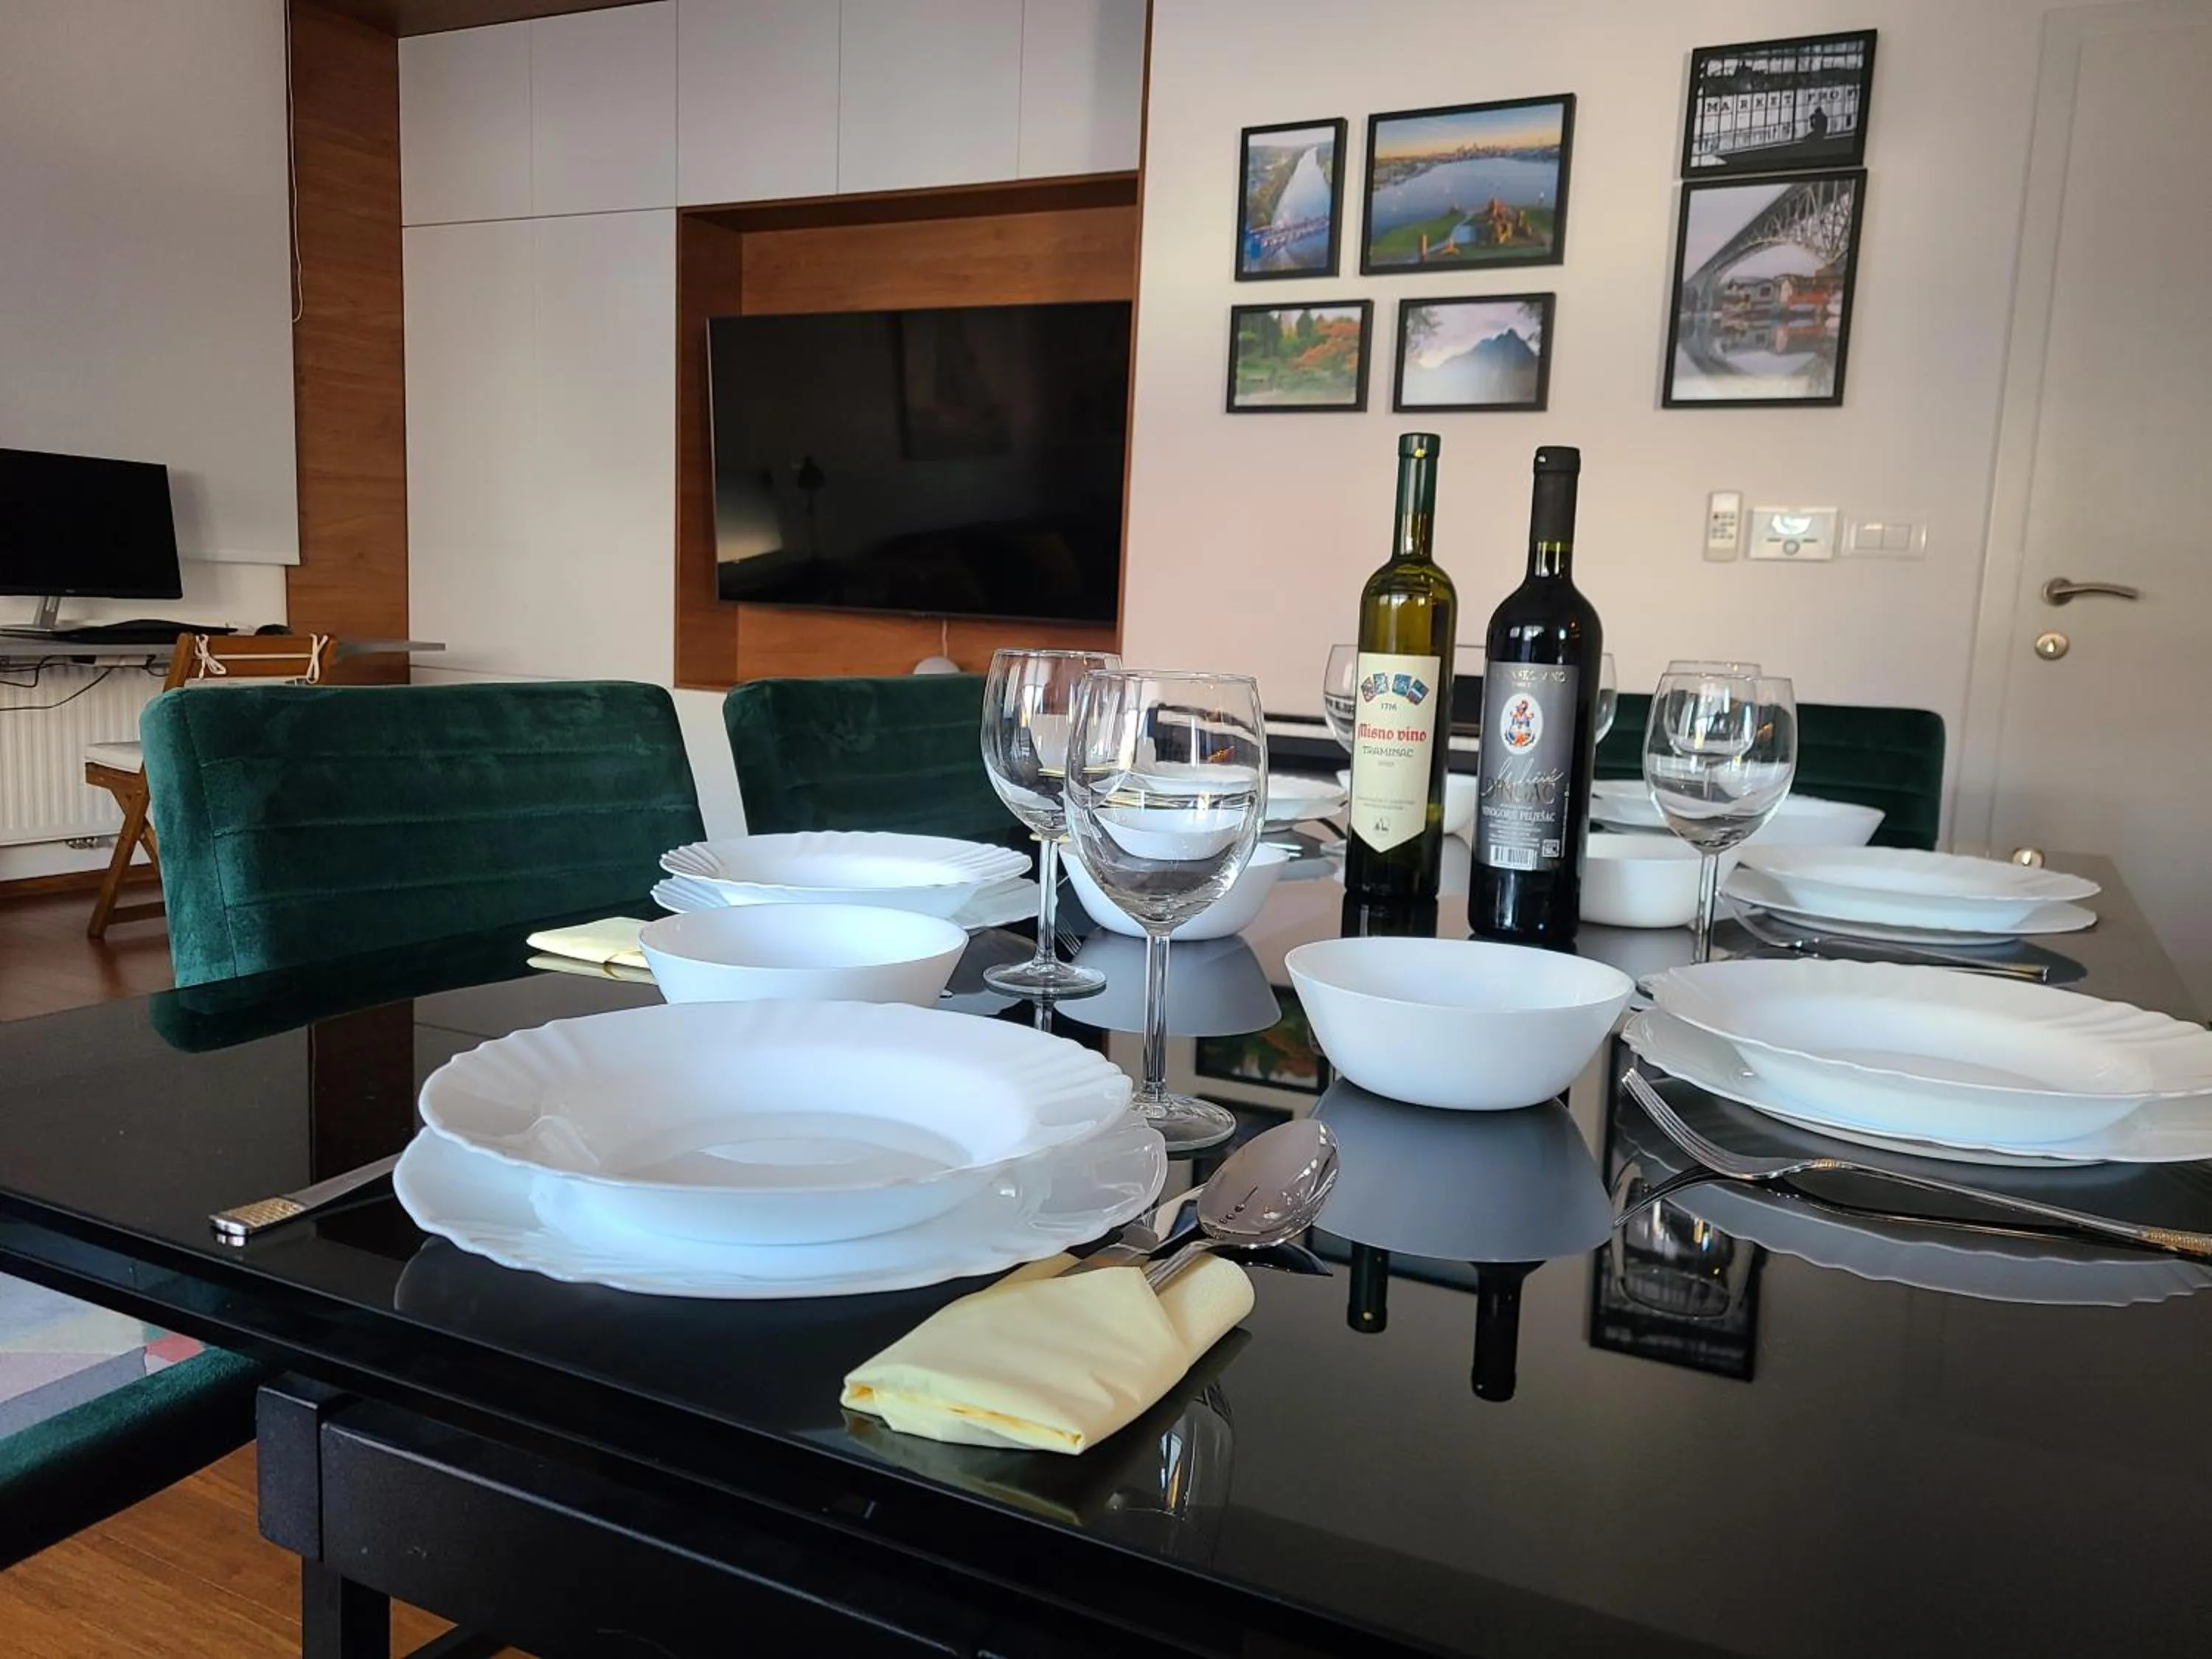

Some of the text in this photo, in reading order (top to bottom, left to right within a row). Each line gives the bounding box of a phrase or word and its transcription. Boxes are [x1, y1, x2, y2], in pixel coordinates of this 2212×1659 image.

[1706, 95, 1792, 113] MARKET
[1357, 723, 1427, 742] Misno vino
[1363, 745, 1414, 757] TRAMINAC
